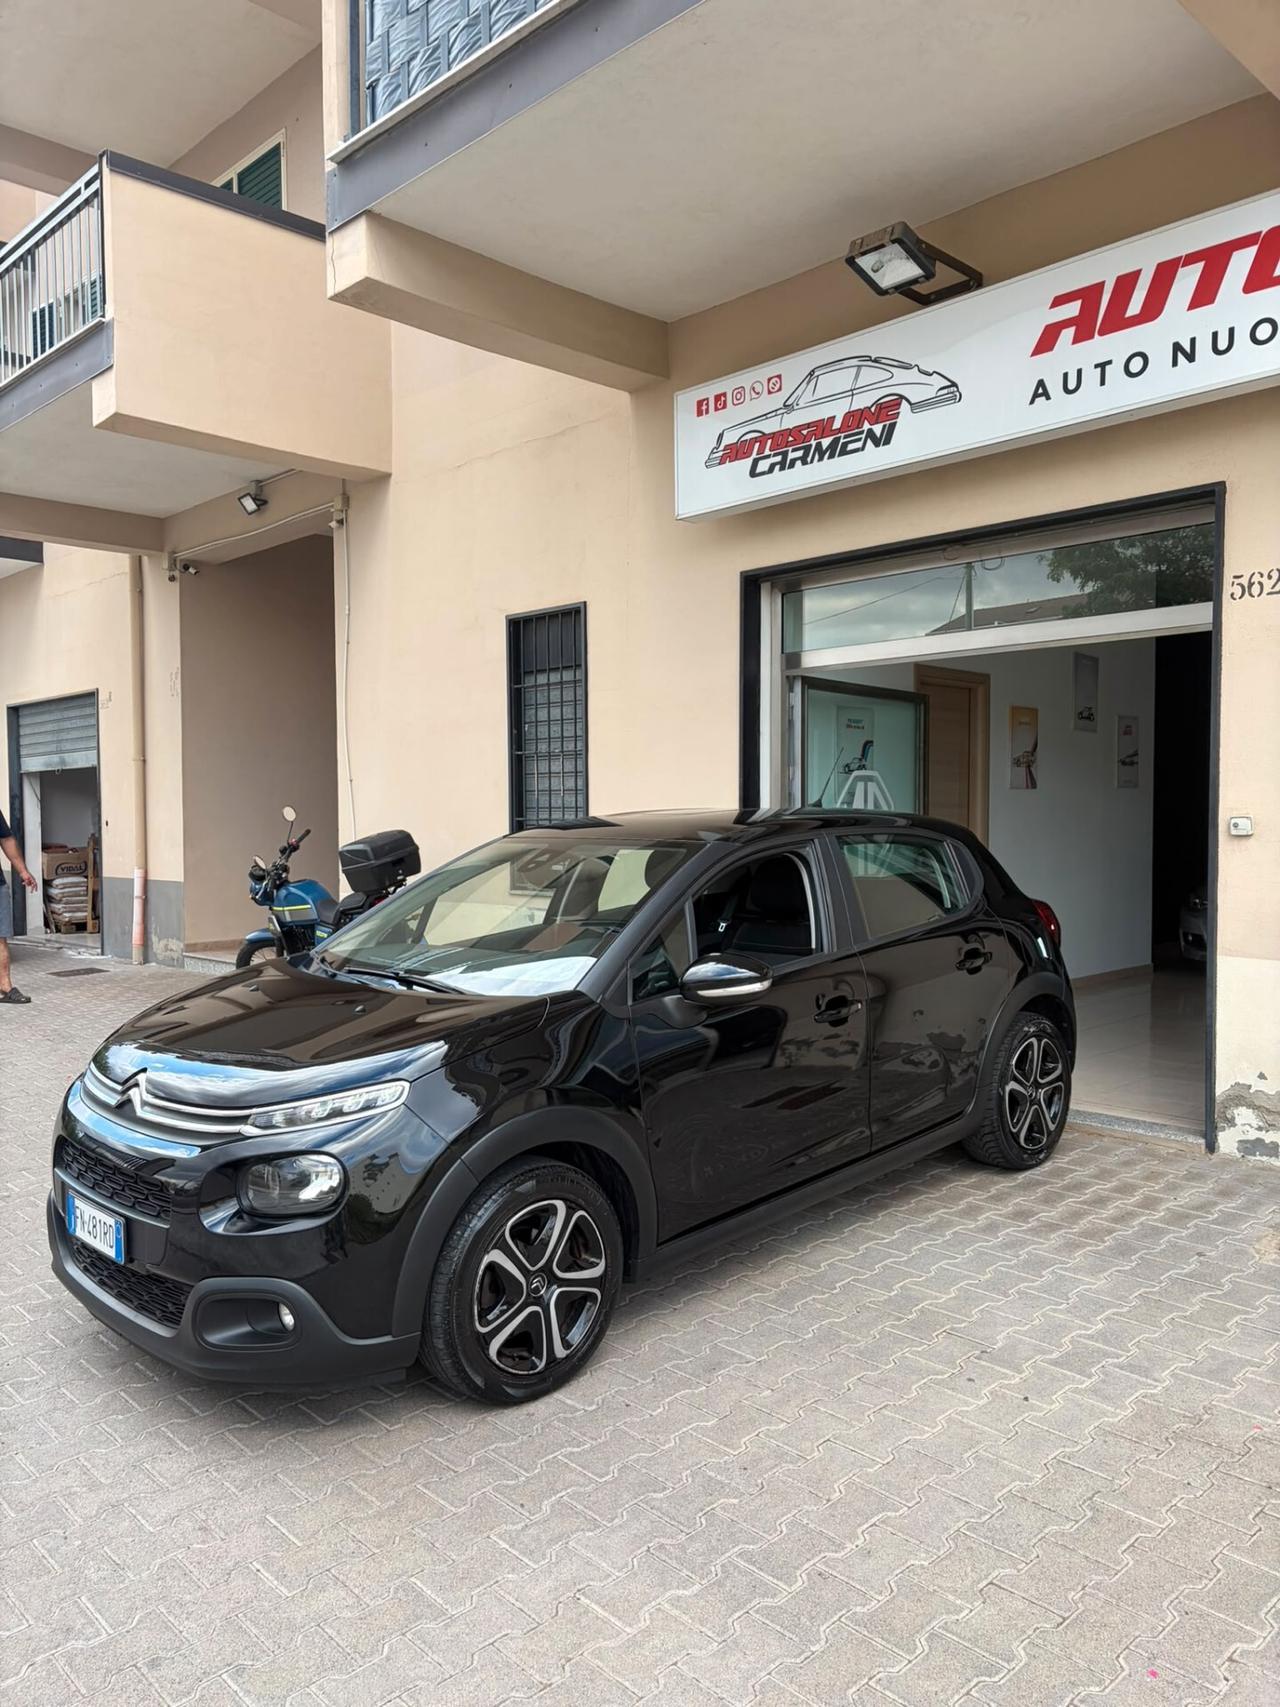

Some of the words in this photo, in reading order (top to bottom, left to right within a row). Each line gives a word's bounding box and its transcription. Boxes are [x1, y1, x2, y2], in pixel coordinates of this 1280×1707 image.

[1029, 351, 1150, 405] AUTO
[1171, 317, 1279, 368] NUO
[719, 395, 902, 465] AUTOSALONE
[749, 421, 898, 478] CARMENI
[1230, 568, 1280, 601] 562
[60, 864, 84, 873] VIDAL
